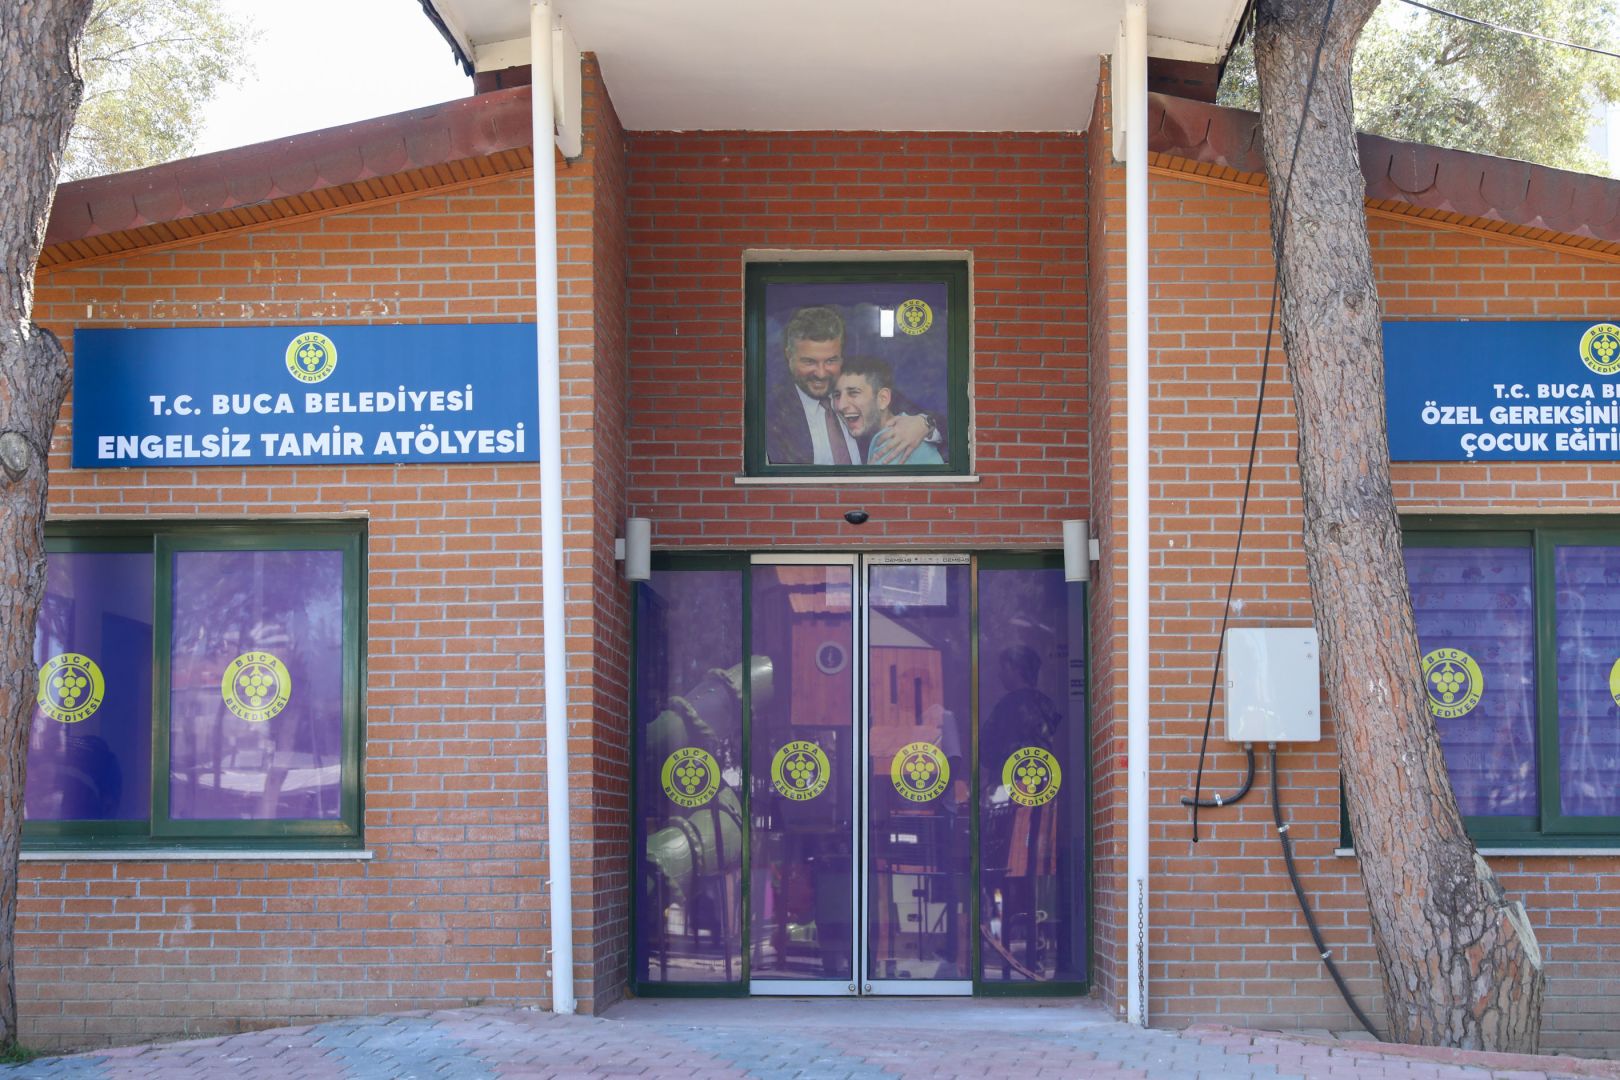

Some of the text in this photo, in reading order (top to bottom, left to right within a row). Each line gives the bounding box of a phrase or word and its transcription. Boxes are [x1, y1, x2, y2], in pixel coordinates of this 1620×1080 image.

[1591, 326, 1619, 336] BUCA
[297, 335, 326, 345] BUCA
[1493, 384, 1530, 399] T.C.
[1537, 384, 1595, 399] BUCA
[150, 384, 473, 416] T.C. BUCA BELEDİYESİ
[1421, 400, 1620, 425] ÖZEL GEREKSİNİ
[98, 422, 525, 459] ENGELSİZ TAMİR ATÖLYESİ
[1460, 427, 1620, 458] ÇOCUK EĞİTİ
[50, 656, 91, 669] BUCA
[235, 655, 276, 667] BUCA
[1426, 650, 1468, 664] BUCA
[1431, 693, 1480, 717] LEDİYESİ
[673, 750, 708, 761] BUCA
[783, 743, 818, 755] BUCA
[902, 744, 938, 756] BUCA
[1014, 749, 1049, 760] BUCA
